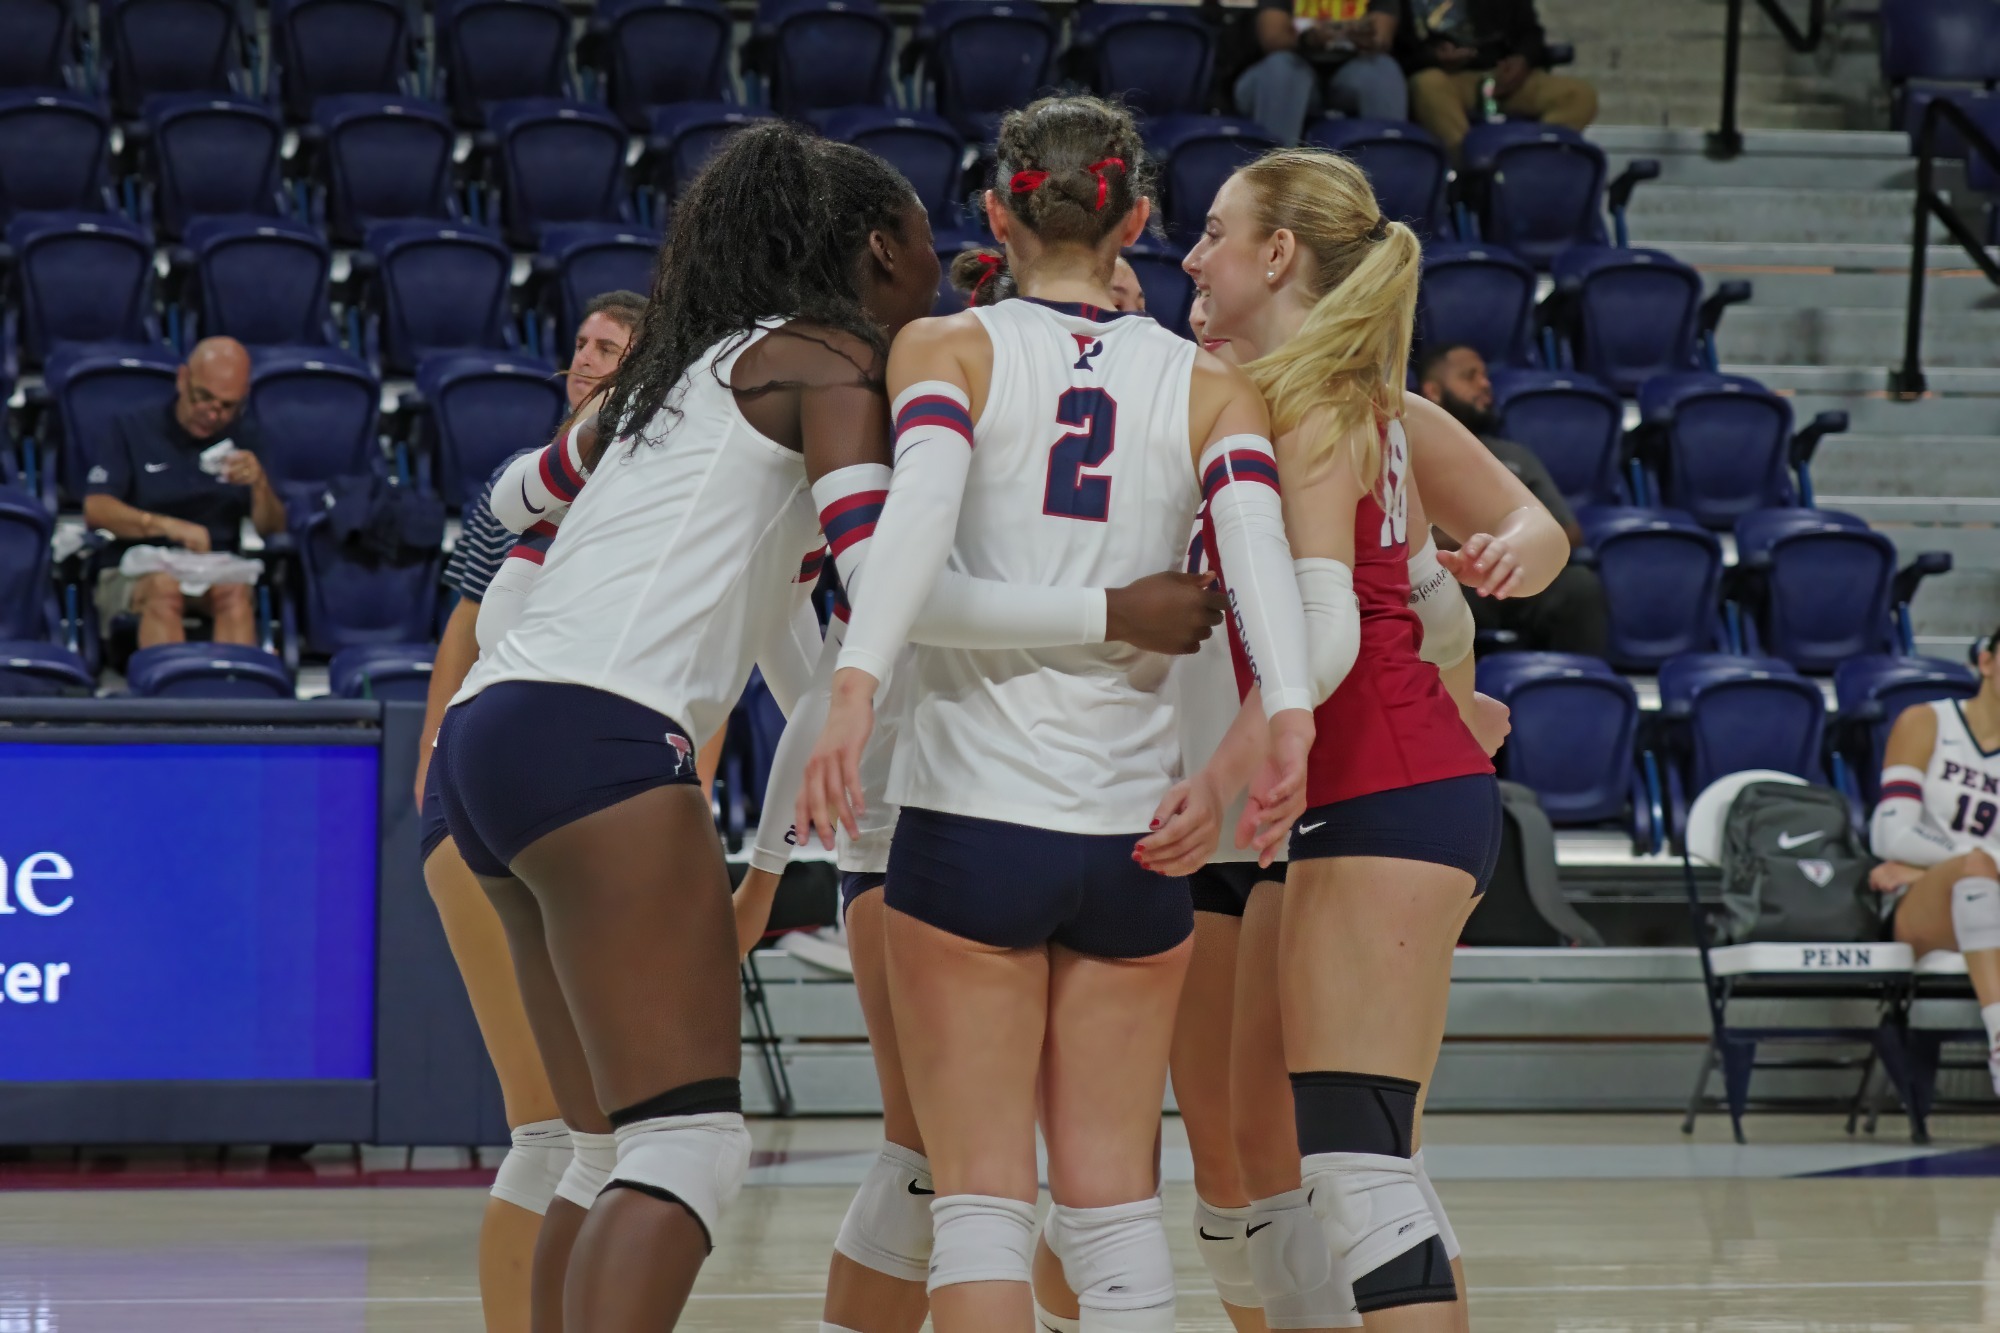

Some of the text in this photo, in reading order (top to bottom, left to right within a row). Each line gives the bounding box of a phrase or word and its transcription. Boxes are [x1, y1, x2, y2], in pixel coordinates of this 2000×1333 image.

[1043, 386, 1117, 522] 2
[1950, 793, 1998, 838] 19
[0, 852, 74, 916] e
[1802, 949, 1870, 967] PENN
[0, 962, 70, 1004] er
